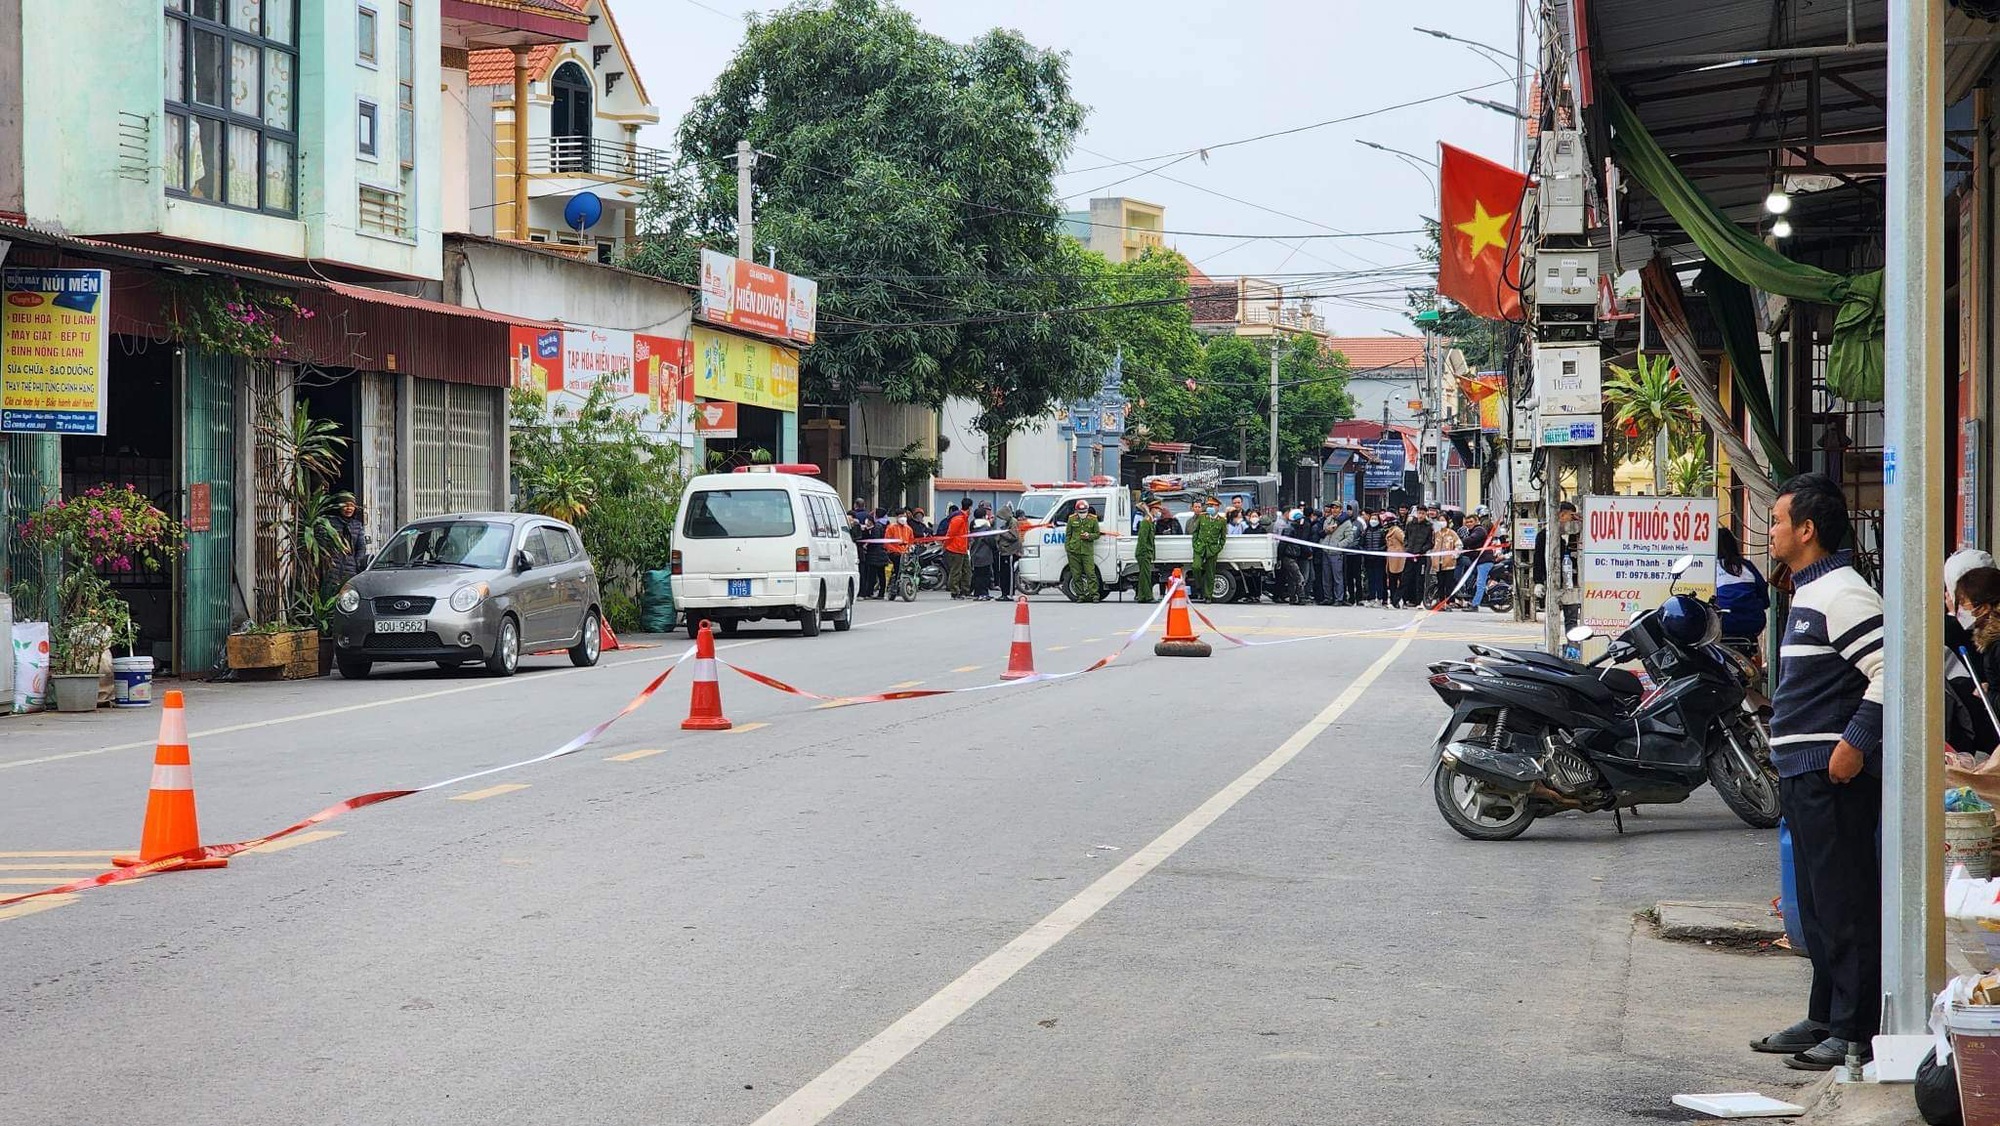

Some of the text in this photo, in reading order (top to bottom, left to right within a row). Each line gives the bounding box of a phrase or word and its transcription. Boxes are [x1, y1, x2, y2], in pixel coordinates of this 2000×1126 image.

[42, 275, 65, 291] NÚI
[69, 273, 98, 292] MẾN
[757, 293, 785, 321] DUYÊN
[568, 350, 579, 373] TẠP
[1590, 501, 1710, 542] QUẦY THUỐC SỐ 23
[1633, 543, 1650, 552] Phùng
[1651, 544, 1660, 552] Thị
[1595, 558, 1608, 567] ĐC:
[1611, 558, 1634, 568] Thuận
[1636, 558, 1660, 567] Thành
[731, 587, 747, 595] 1115
[1585, 589, 1642, 600] HAPACOL
[1620, 602, 1639, 612] 250
[377, 621, 423, 632] 30U-9562
